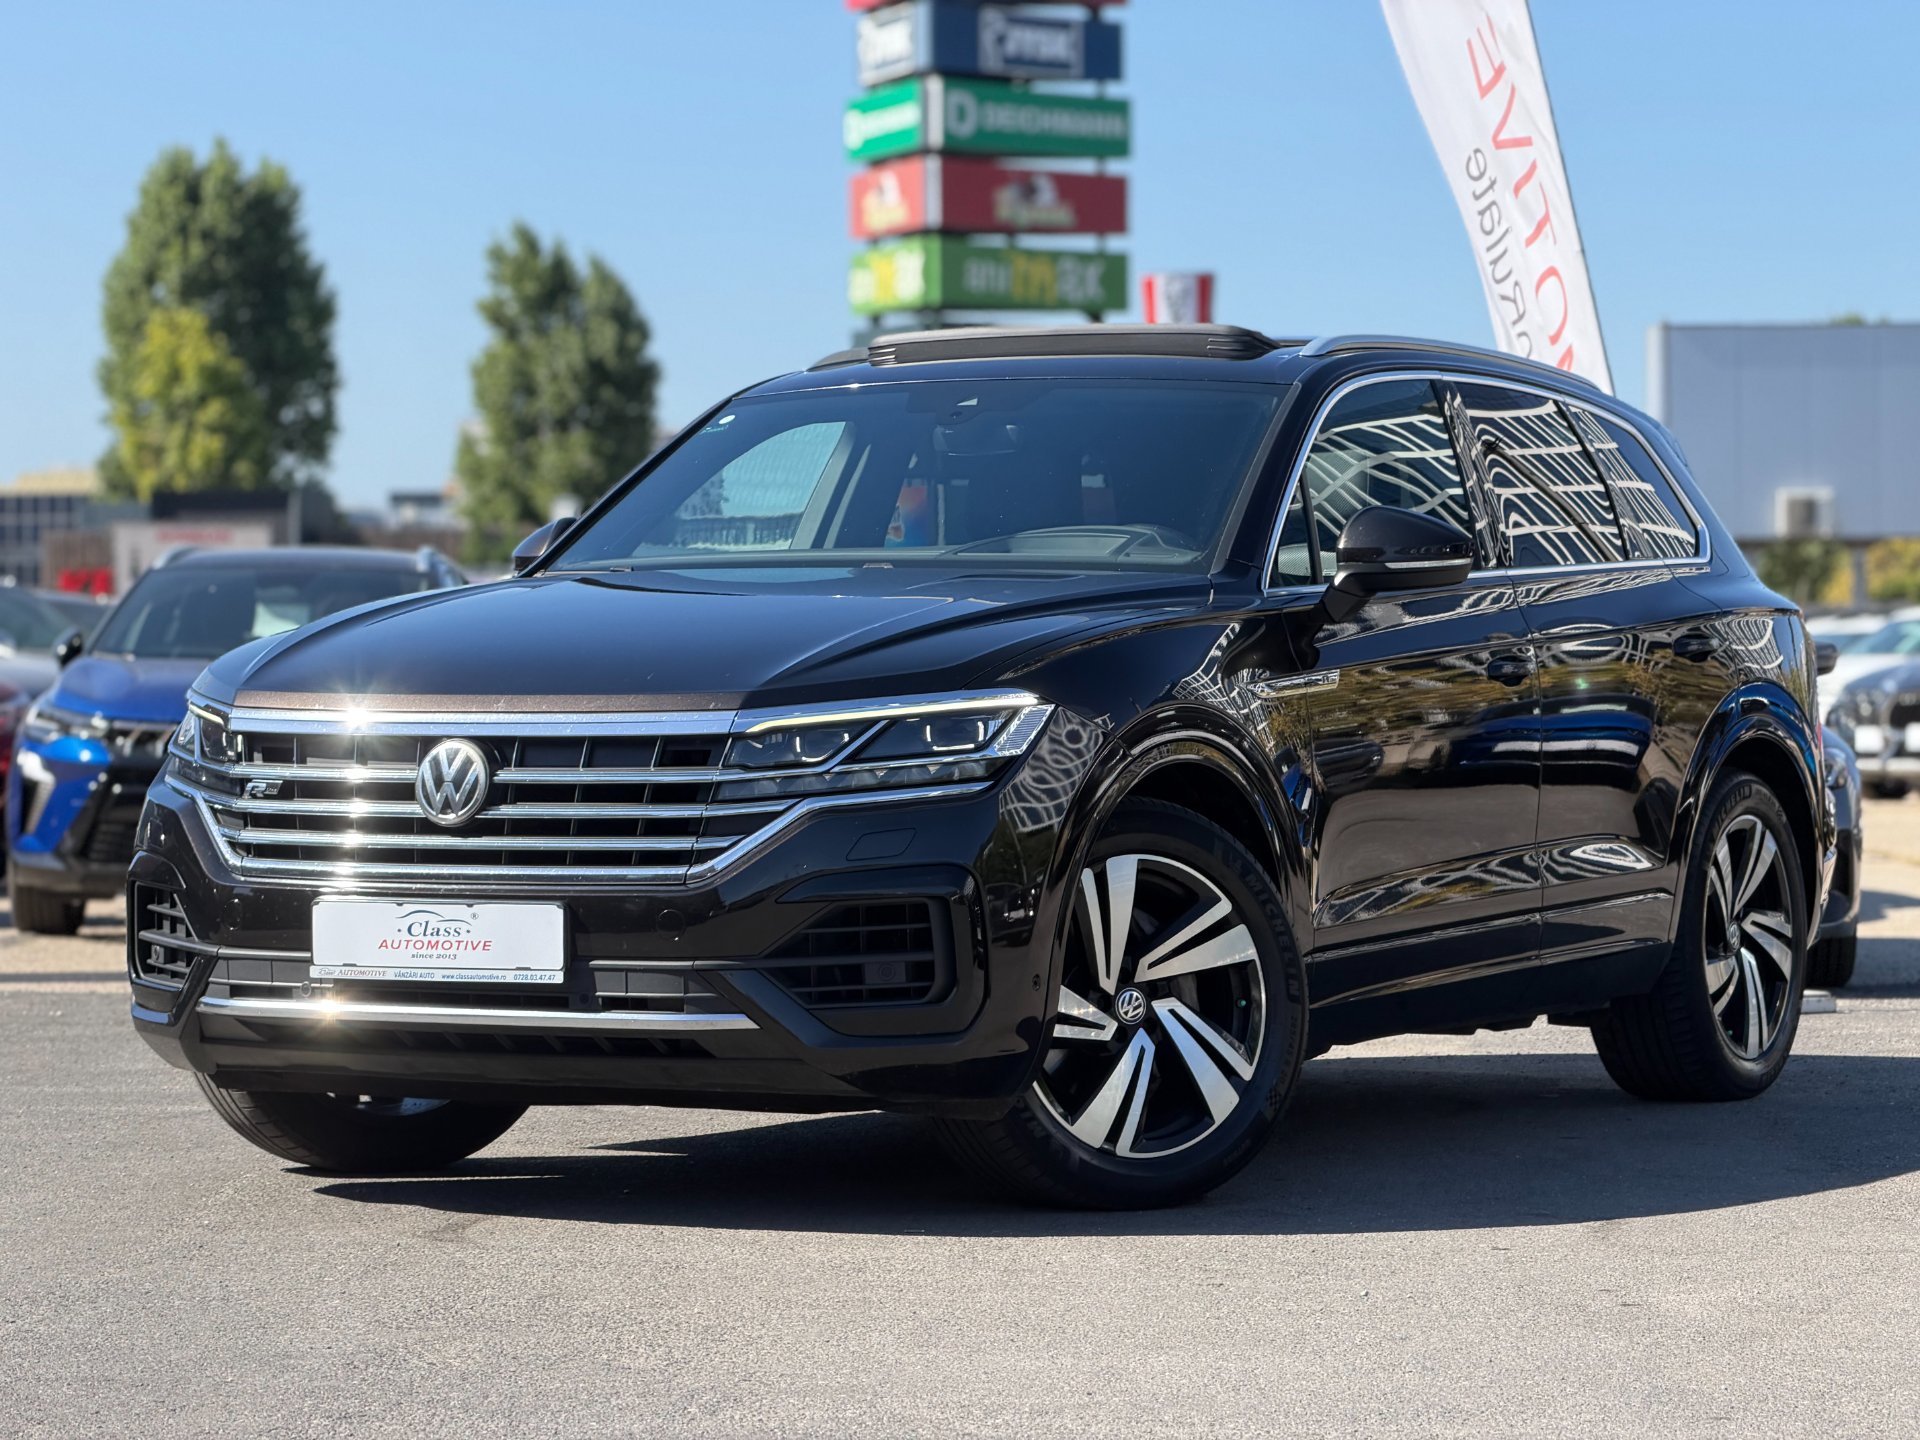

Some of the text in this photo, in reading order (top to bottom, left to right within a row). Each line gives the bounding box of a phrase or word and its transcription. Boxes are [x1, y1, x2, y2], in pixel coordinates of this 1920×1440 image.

[407, 920, 461, 937] Class
[378, 939, 493, 951] AUTOMOTIVE
[411, 952, 434, 960] since
[337, 969, 387, 977] AUTOMOTIVE
[419, 971, 435, 979] AUTO
[441, 973, 507, 981] www.classautomotive.ro
